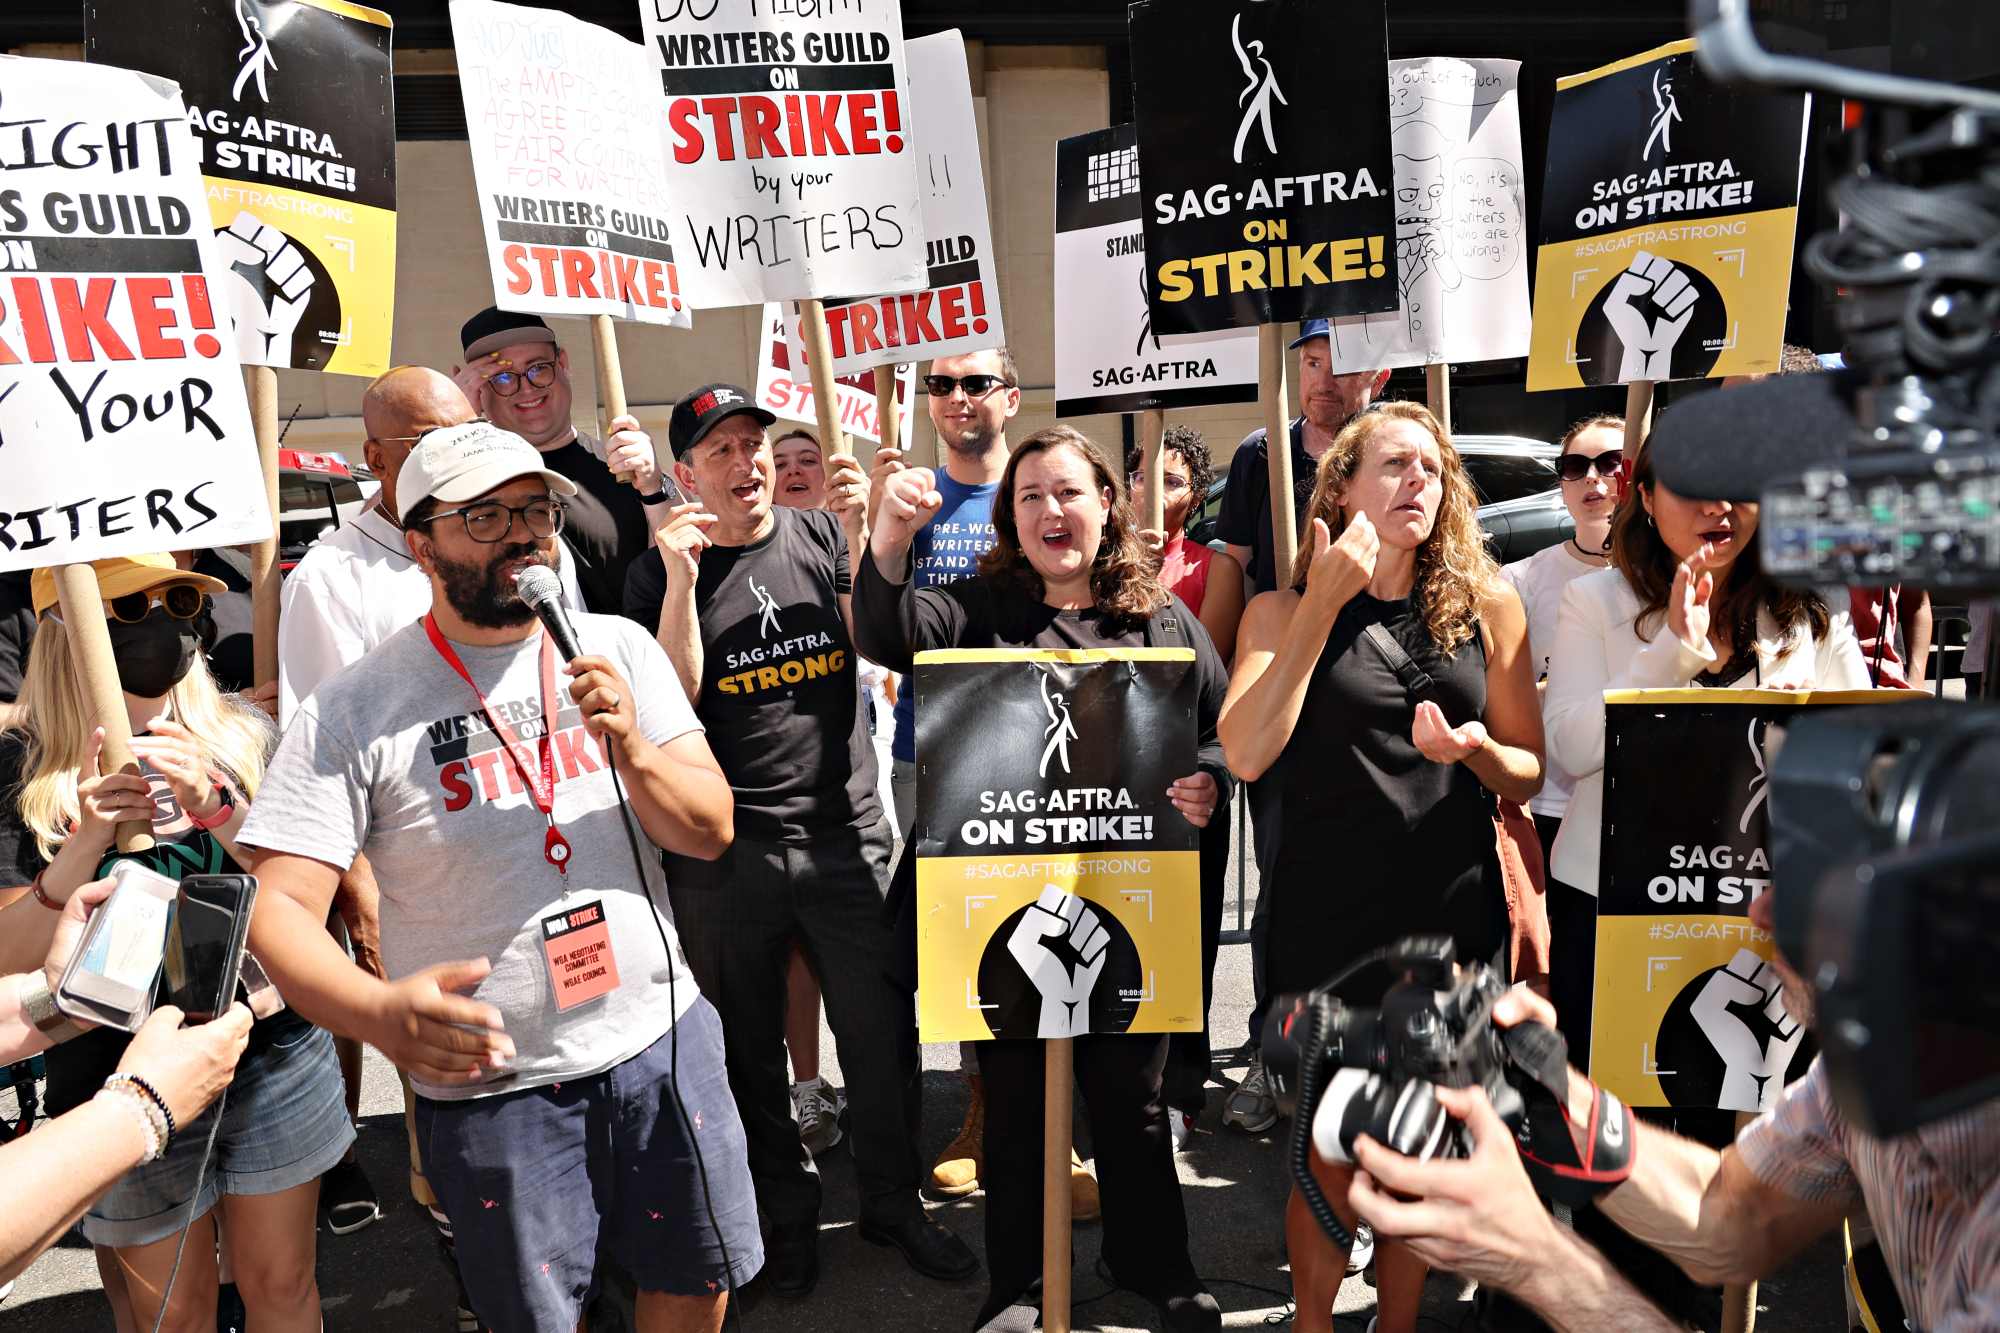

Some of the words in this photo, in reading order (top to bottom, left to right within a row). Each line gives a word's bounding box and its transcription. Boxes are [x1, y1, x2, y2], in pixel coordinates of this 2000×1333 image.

[656, 31, 796, 66] WRITERS
[803, 31, 890, 63] GUILD
[769, 68, 799, 90] ON
[668, 90, 904, 165] STRIKE!
[0, 117, 186, 177] IGHT
[494, 131, 570, 166] FAIR
[216, 143, 356, 193] STRIKE!
[507, 165, 569, 190] FOR
[752, 165, 780, 204] by
[791, 171, 833, 200] your
[43, 192, 191, 235] GUILD
[493, 194, 606, 227] WRITERS
[611, 209, 669, 241] GUILD
[1575, 204, 1618, 230] ON
[1626, 181, 1753, 220] STRIKE!
[585, 229, 609, 248] ON
[686, 204, 903, 271] WRITERS
[1243, 219, 1288, 243] ON
[1575, 221, 1747, 258] #SAGAFTRASTRONG
[503, 244, 682, 312] STRIKE!
[1158, 235, 1386, 302] STRIKE!
[917, 556, 969, 569] STAND
[718, 650, 846, 695] STRONG
[961, 819, 1014, 845] ON
[1024, 816, 1154, 845] STRIKE!
[963, 859, 1151, 880] #SAGAFTRASTRONG
[1647, 876, 1705, 903] ON
[546, 917, 569, 935] WGA
[569, 906, 599, 928] STRIKE
[553, 954, 569, 967] WGA
[569, 941, 607, 961] NEGOTIATING
[565, 953, 600, 973] COMMITTEE
